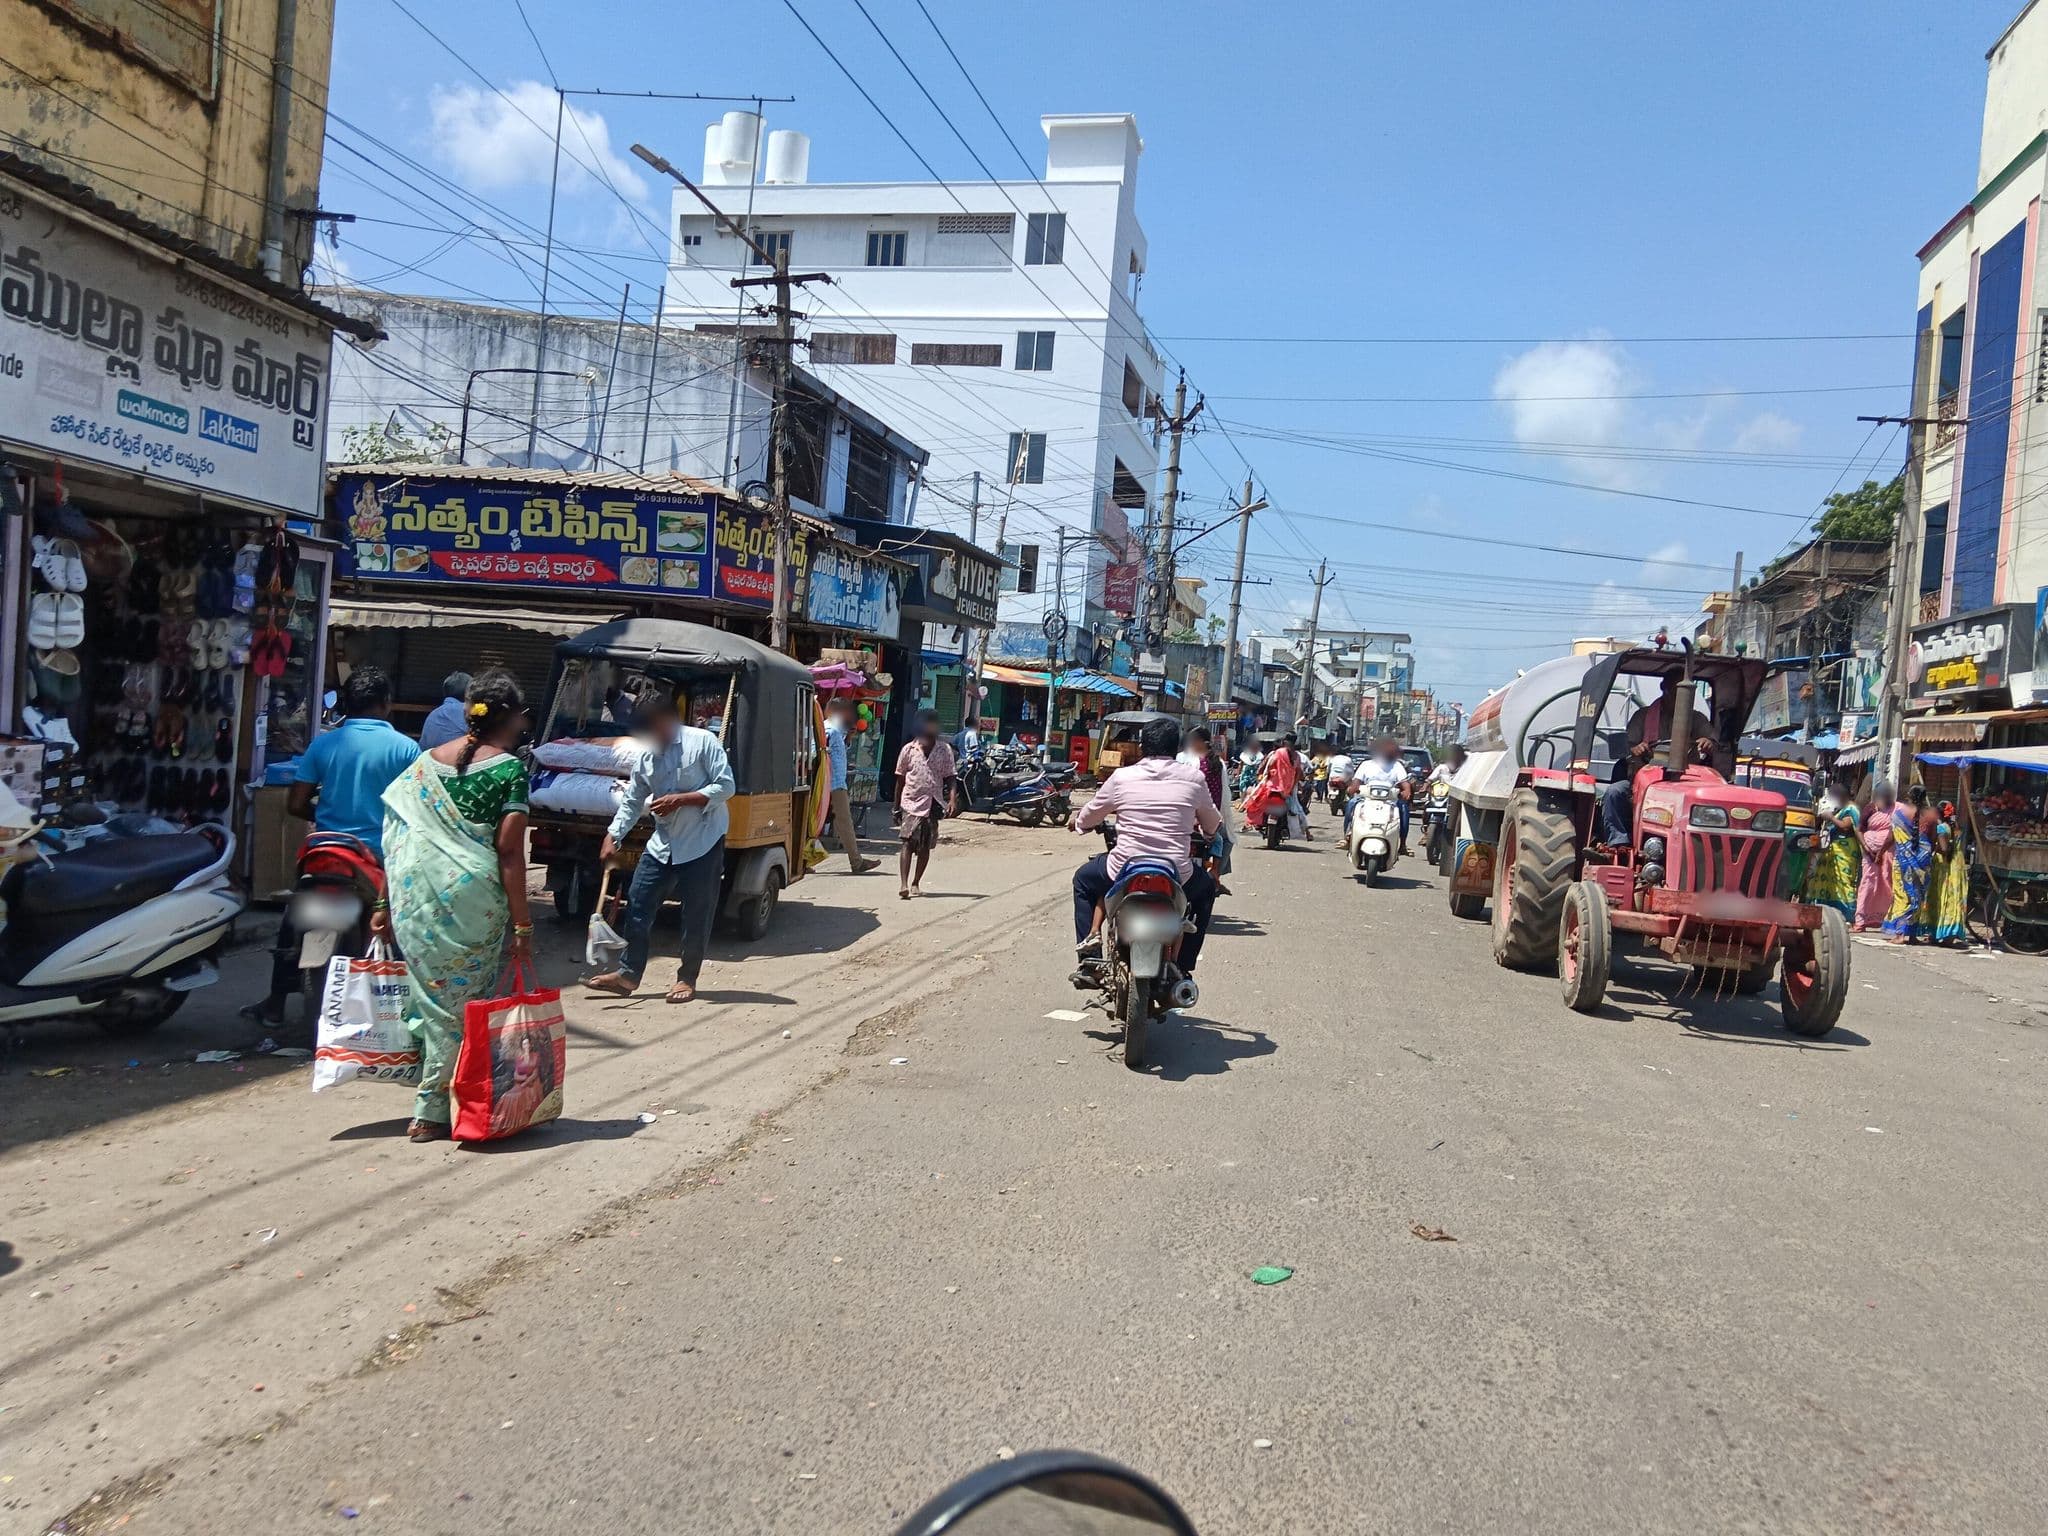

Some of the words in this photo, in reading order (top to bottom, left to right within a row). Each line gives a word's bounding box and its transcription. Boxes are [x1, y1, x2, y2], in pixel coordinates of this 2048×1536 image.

[119, 397, 188, 430] walkmate
[201, 408, 258, 449] Lakhani
[392, 495, 510, 550] సత్యం
[520, 497, 648, 554] టిఫిన్స్
[450, 555, 495, 579] స్పెషల్
